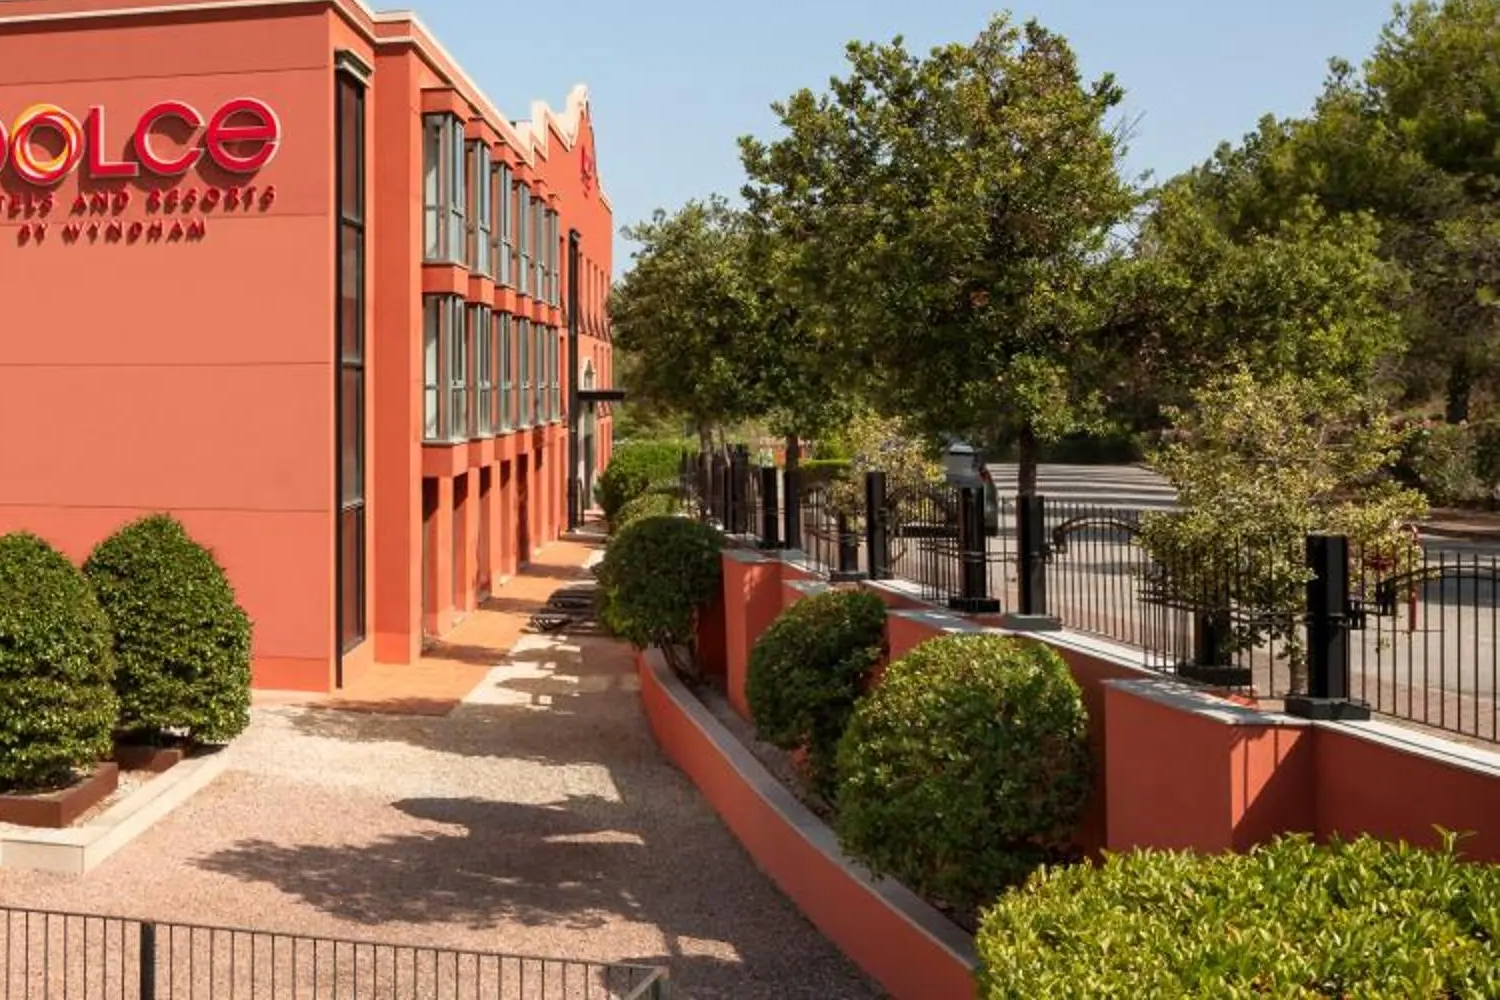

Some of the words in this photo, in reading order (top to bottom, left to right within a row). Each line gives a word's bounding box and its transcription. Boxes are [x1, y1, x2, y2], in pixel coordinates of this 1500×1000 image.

[70, 184, 133, 217] AND
[145, 185, 276, 216] RESORTS
[17, 221, 49, 247] BY
[61, 216, 206, 246] WYNDHAM
